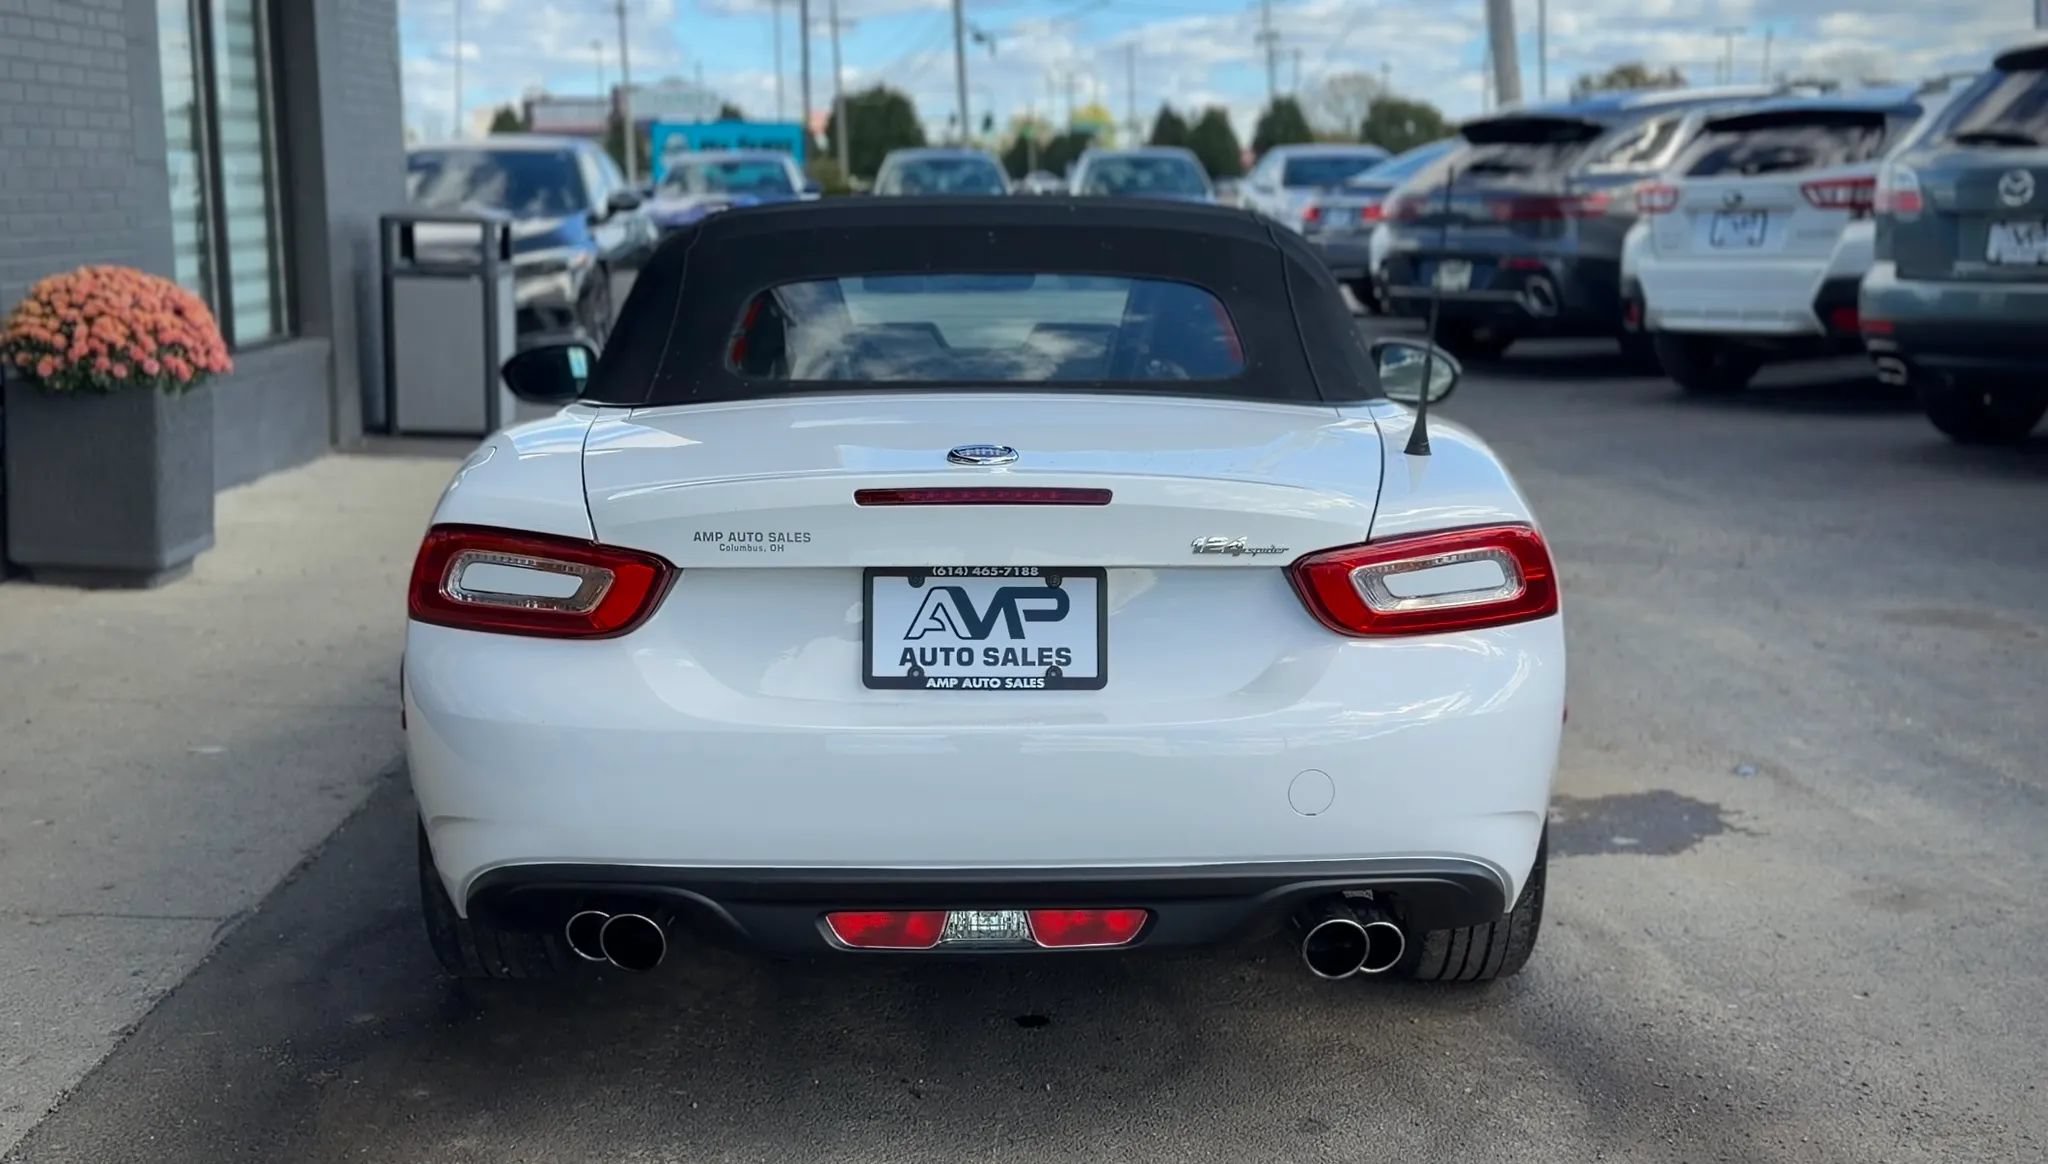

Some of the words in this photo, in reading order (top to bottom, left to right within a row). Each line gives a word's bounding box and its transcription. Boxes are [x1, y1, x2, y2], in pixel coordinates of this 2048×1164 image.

[693, 531, 724, 542] AMP
[728, 531, 764, 542] AUTO
[768, 532, 812, 543] SALES
[719, 543, 767, 552] Columbus,
[770, 544, 785, 552] OH
[932, 566, 969, 576] (614)
[972, 566, 1039, 576] 465-7188
[903, 586, 1070, 640] AMP
[899, 647, 974, 667] AUTO
[983, 647, 1072, 667] SALES
[926, 678, 958, 689] AMP
[962, 678, 1001, 689] AUTO
[1005, 678, 1045, 689] SALES
